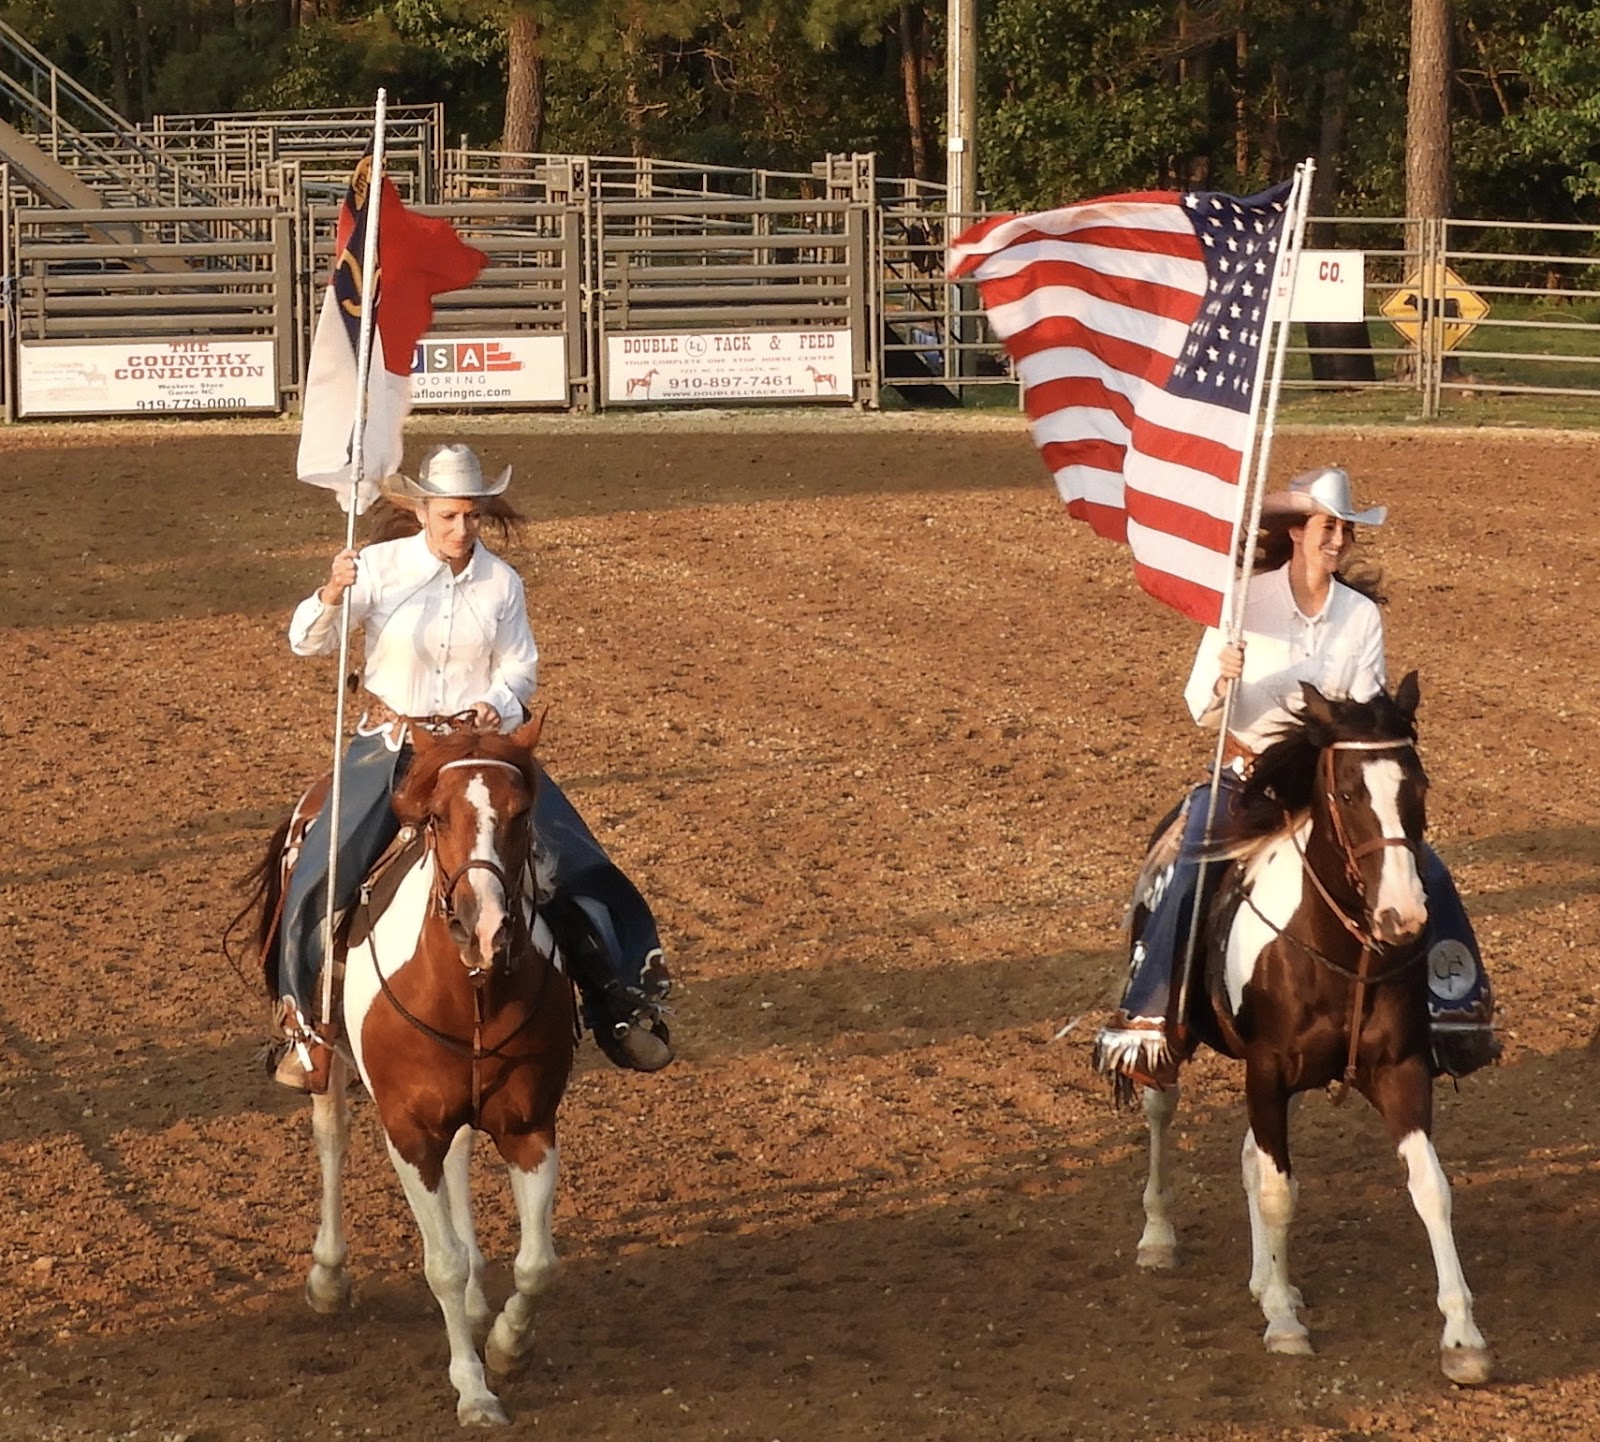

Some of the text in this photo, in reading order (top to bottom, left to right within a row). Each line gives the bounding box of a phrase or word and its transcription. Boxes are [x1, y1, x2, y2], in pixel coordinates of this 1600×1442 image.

[1319, 261, 1344, 283] CO.
[168, 341, 210, 353] THE
[624, 338, 679, 354] DOUBLE
[714, 336, 751, 352] TACK
[769, 335, 781, 350] &
[800, 334, 835, 349] FEED
[127, 353, 252, 368] COUNTRY
[114, 366, 265, 380] CONECTION
[409, 375, 487, 386] OORING
[669, 375, 793, 389] 910-897-7461
[411, 388, 511, 400] aflooringnc.com
